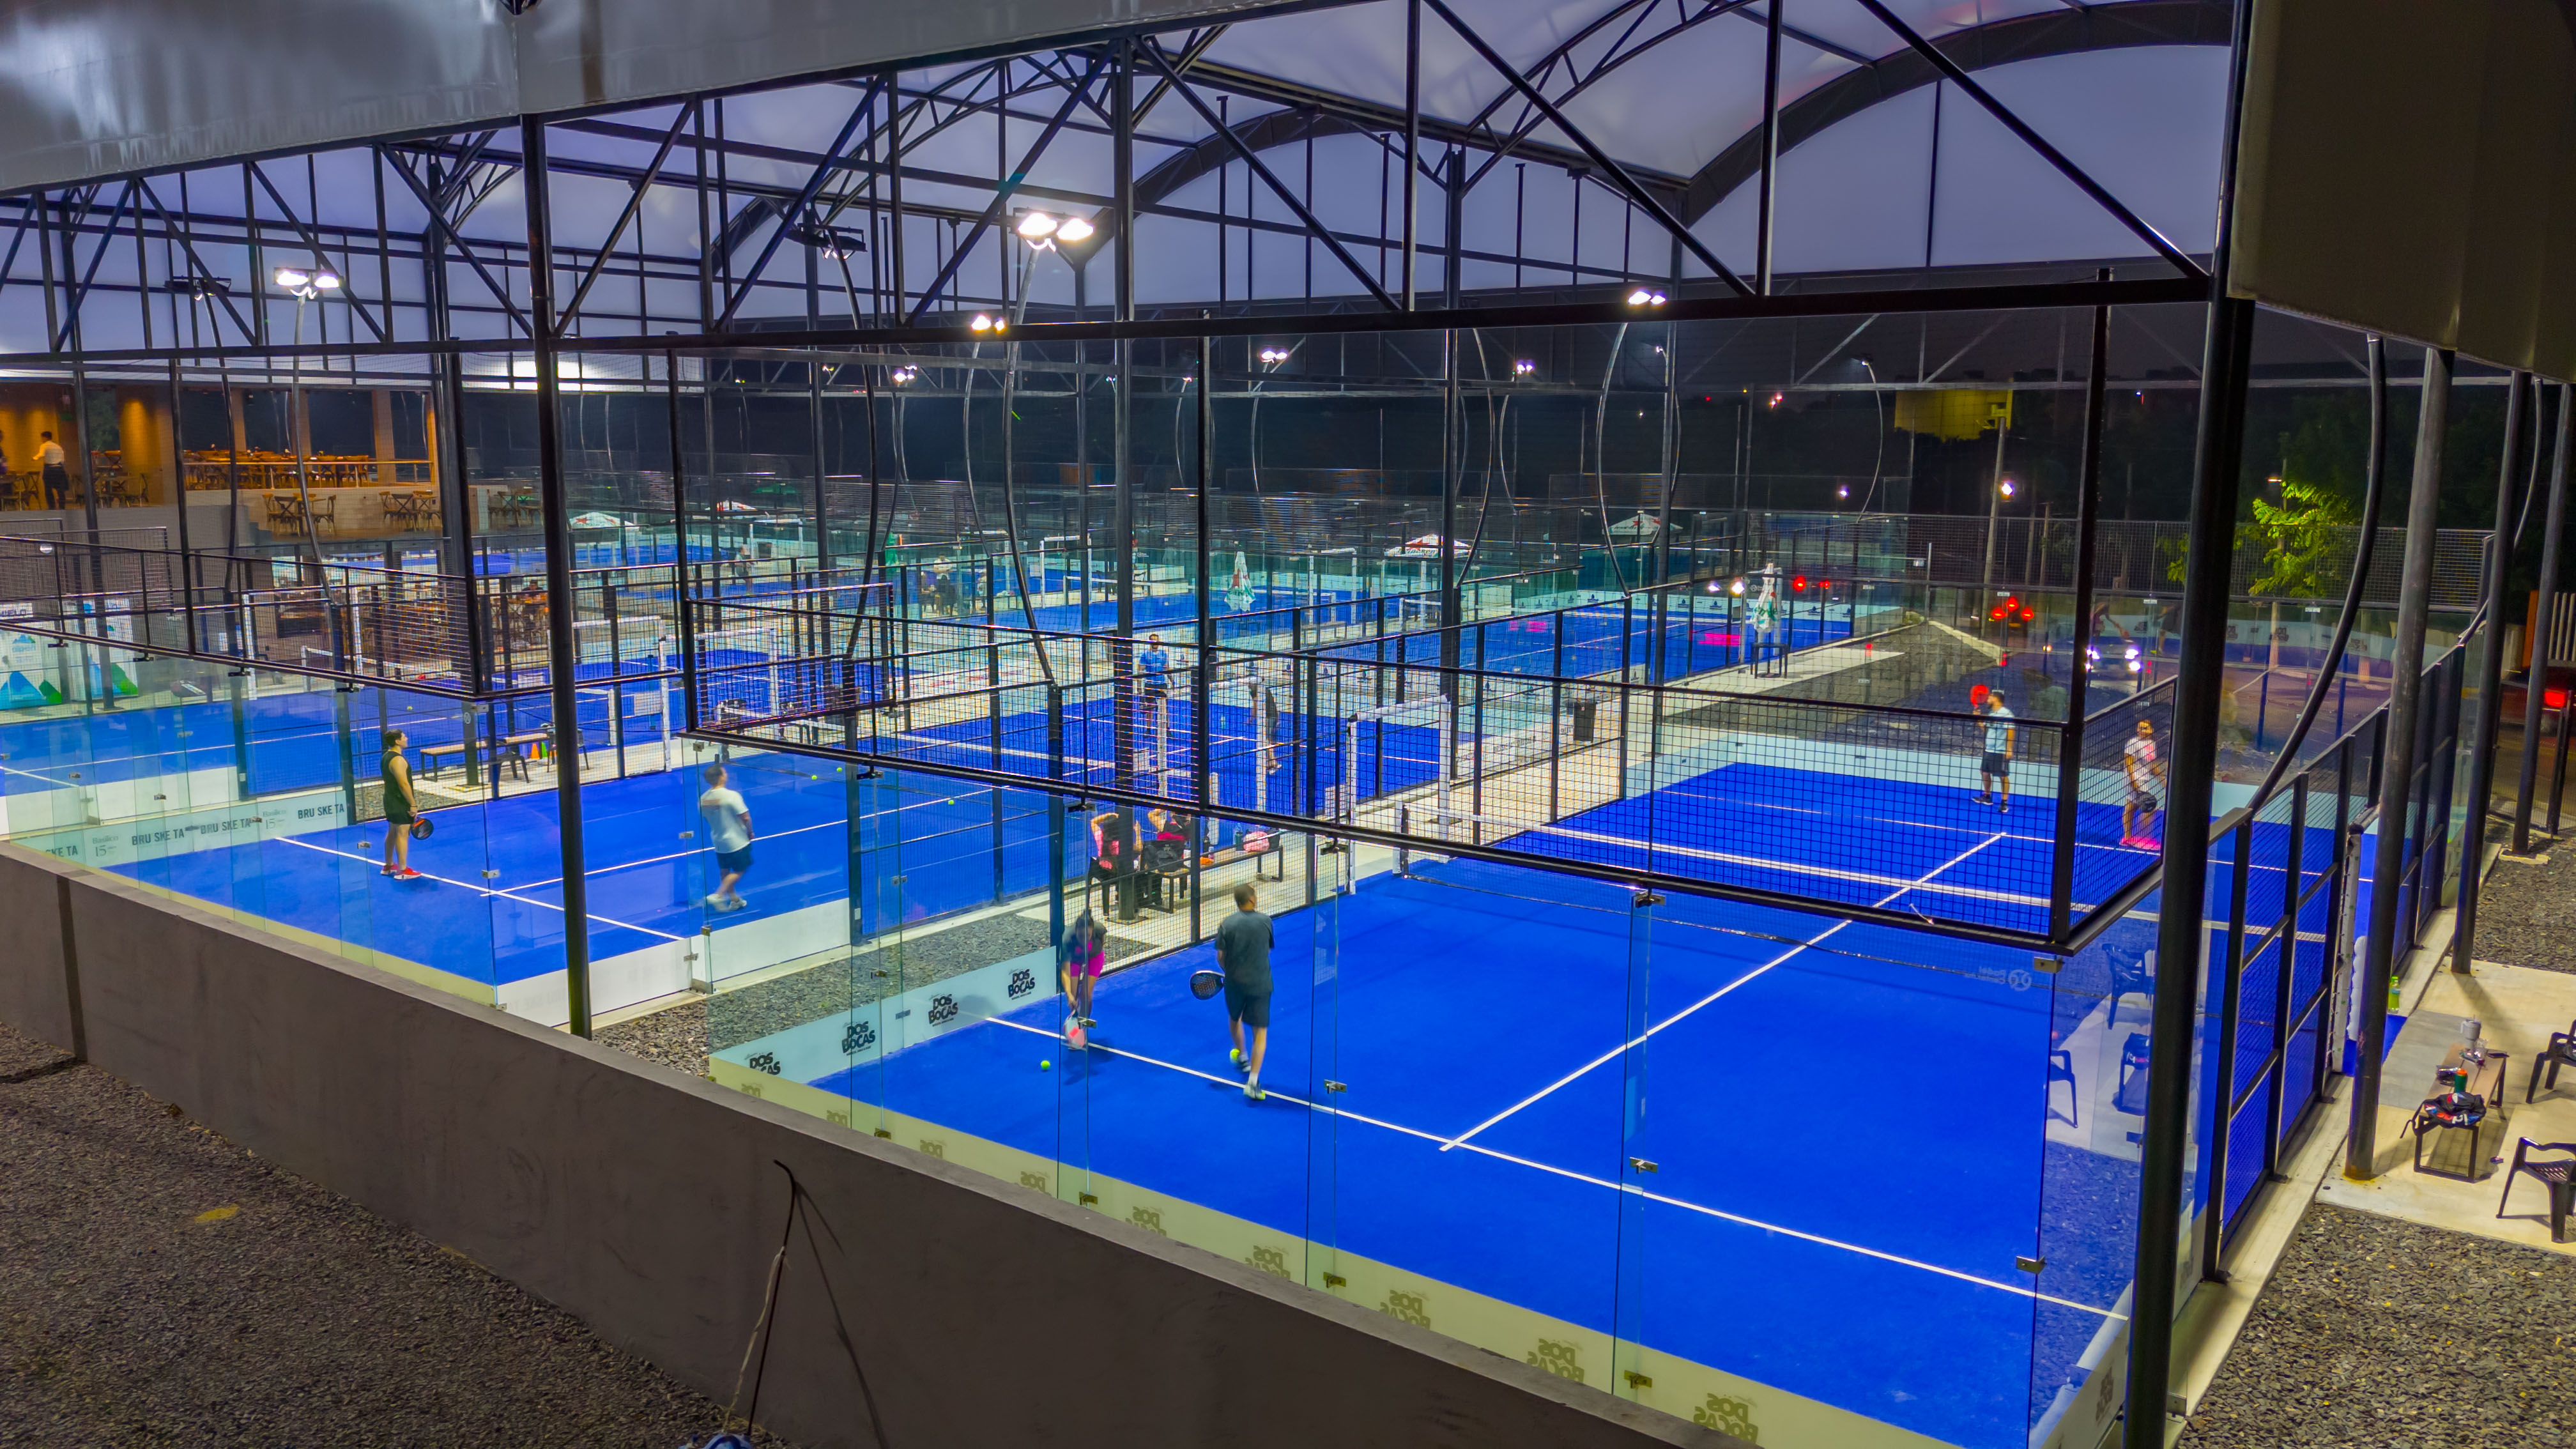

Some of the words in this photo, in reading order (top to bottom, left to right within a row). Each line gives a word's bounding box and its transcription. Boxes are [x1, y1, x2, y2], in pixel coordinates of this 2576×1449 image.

[298, 808, 314, 819] BRU
[318, 805, 333, 816] SKE
[335, 804, 345, 813] TA
[201, 823, 218, 834] BRU
[222, 820, 238, 831] SKE
[240, 818, 250, 829] TA
[132, 834, 151, 846] BRU
[155, 831, 171, 842] SKE
[172, 829, 185, 839] TA
[66, 845, 78, 856] TA
[96, 845, 107, 857] 15
[1012, 969, 1030, 985] DOS
[1008, 977, 1036, 998] BOCAS
[933, 993, 953, 1011] DOS
[928, 1002, 958, 1025] BOCAS
[847, 1020, 869, 1039] DOS
[841, 1029, 875, 1054] BOCAS
[749, 1052, 773, 1069] DOS
